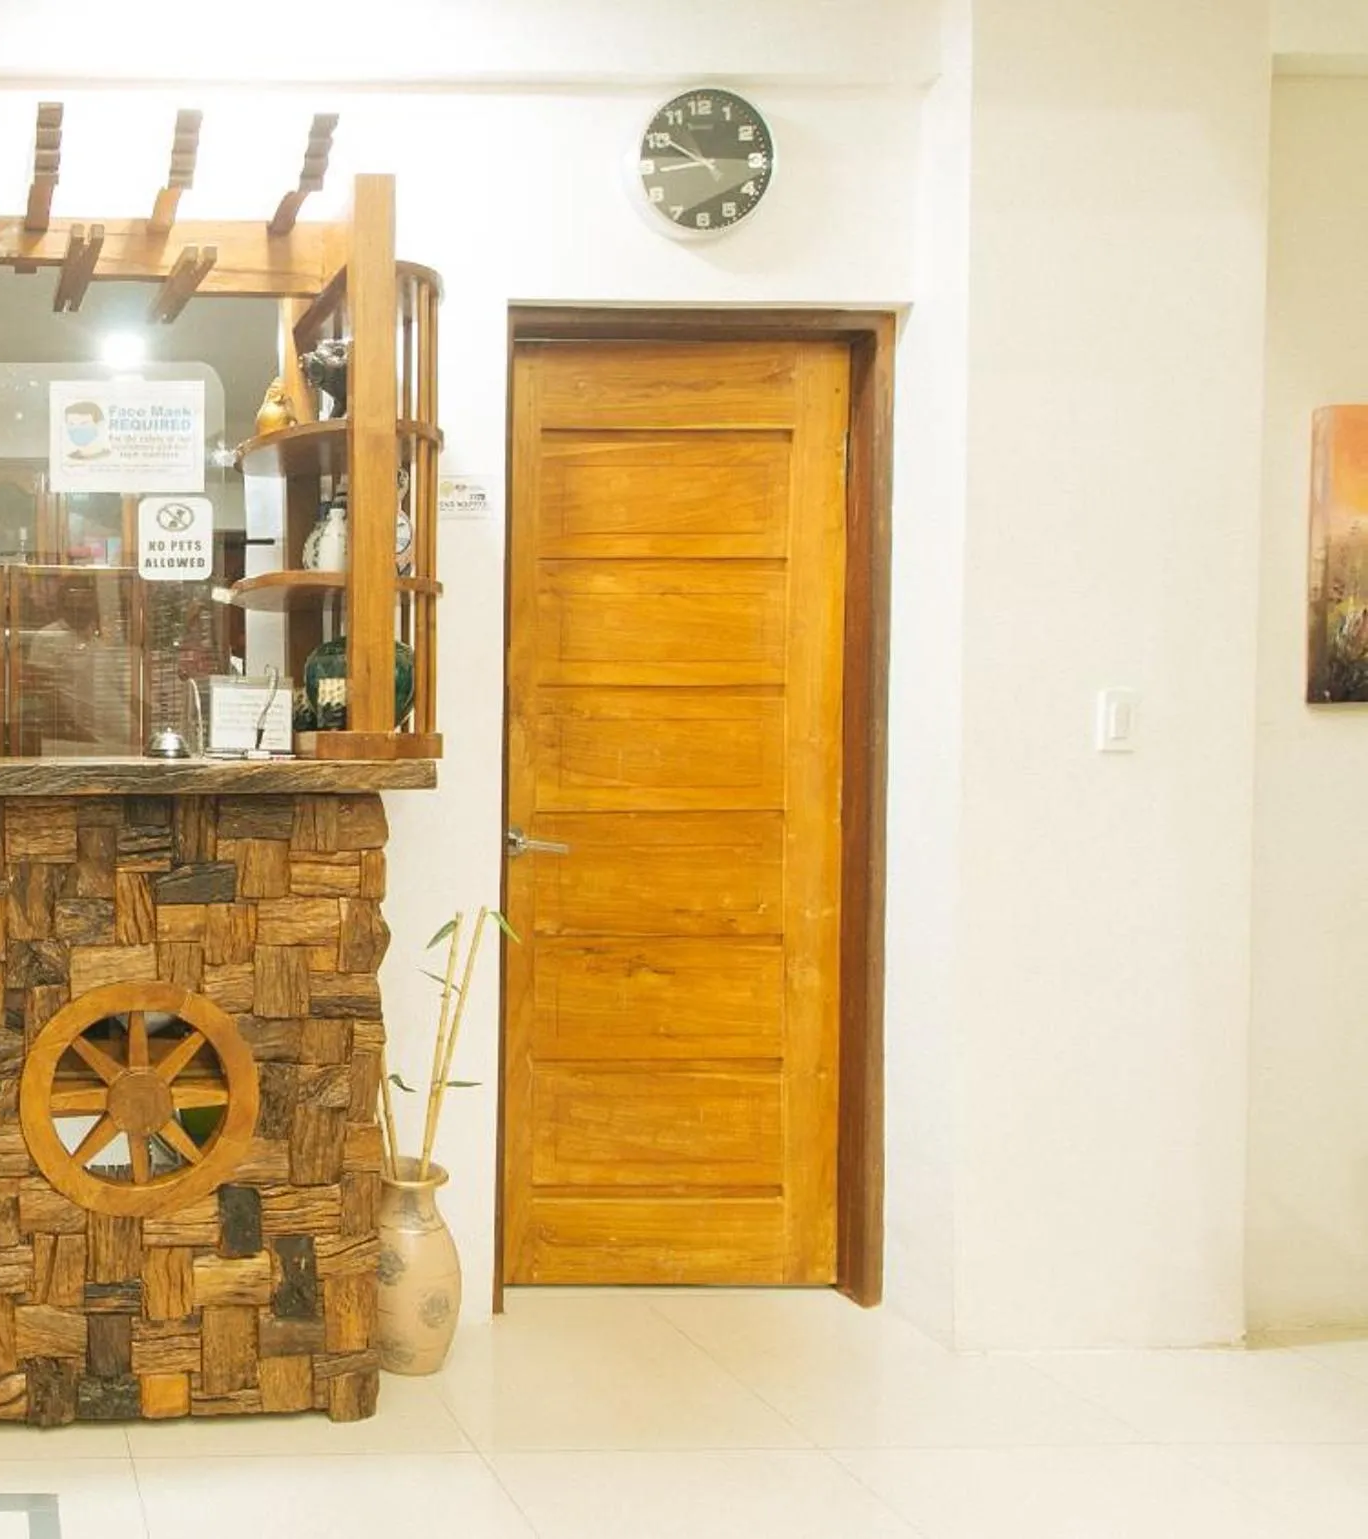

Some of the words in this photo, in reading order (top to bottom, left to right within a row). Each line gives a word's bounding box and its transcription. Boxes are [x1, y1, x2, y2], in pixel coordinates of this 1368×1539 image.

[687, 100, 712, 116] 12
[722, 106, 731, 121] 1
[665, 109, 682, 126] 11
[646, 132, 670, 149] 10
[738, 125, 753, 141] 2
[740, 181, 755, 196] 4
[670, 206, 683, 220] 7
[722, 202, 736, 217] 5
[696, 212, 710, 227] 6
[108, 405, 146, 418] Face
[150, 405, 192, 418] Mask
[108, 418, 192, 431] REQUIRED
[148, 540, 165, 552] NO
[170, 540, 202, 551] PETS
[144, 557, 205, 568] ALLOWED
